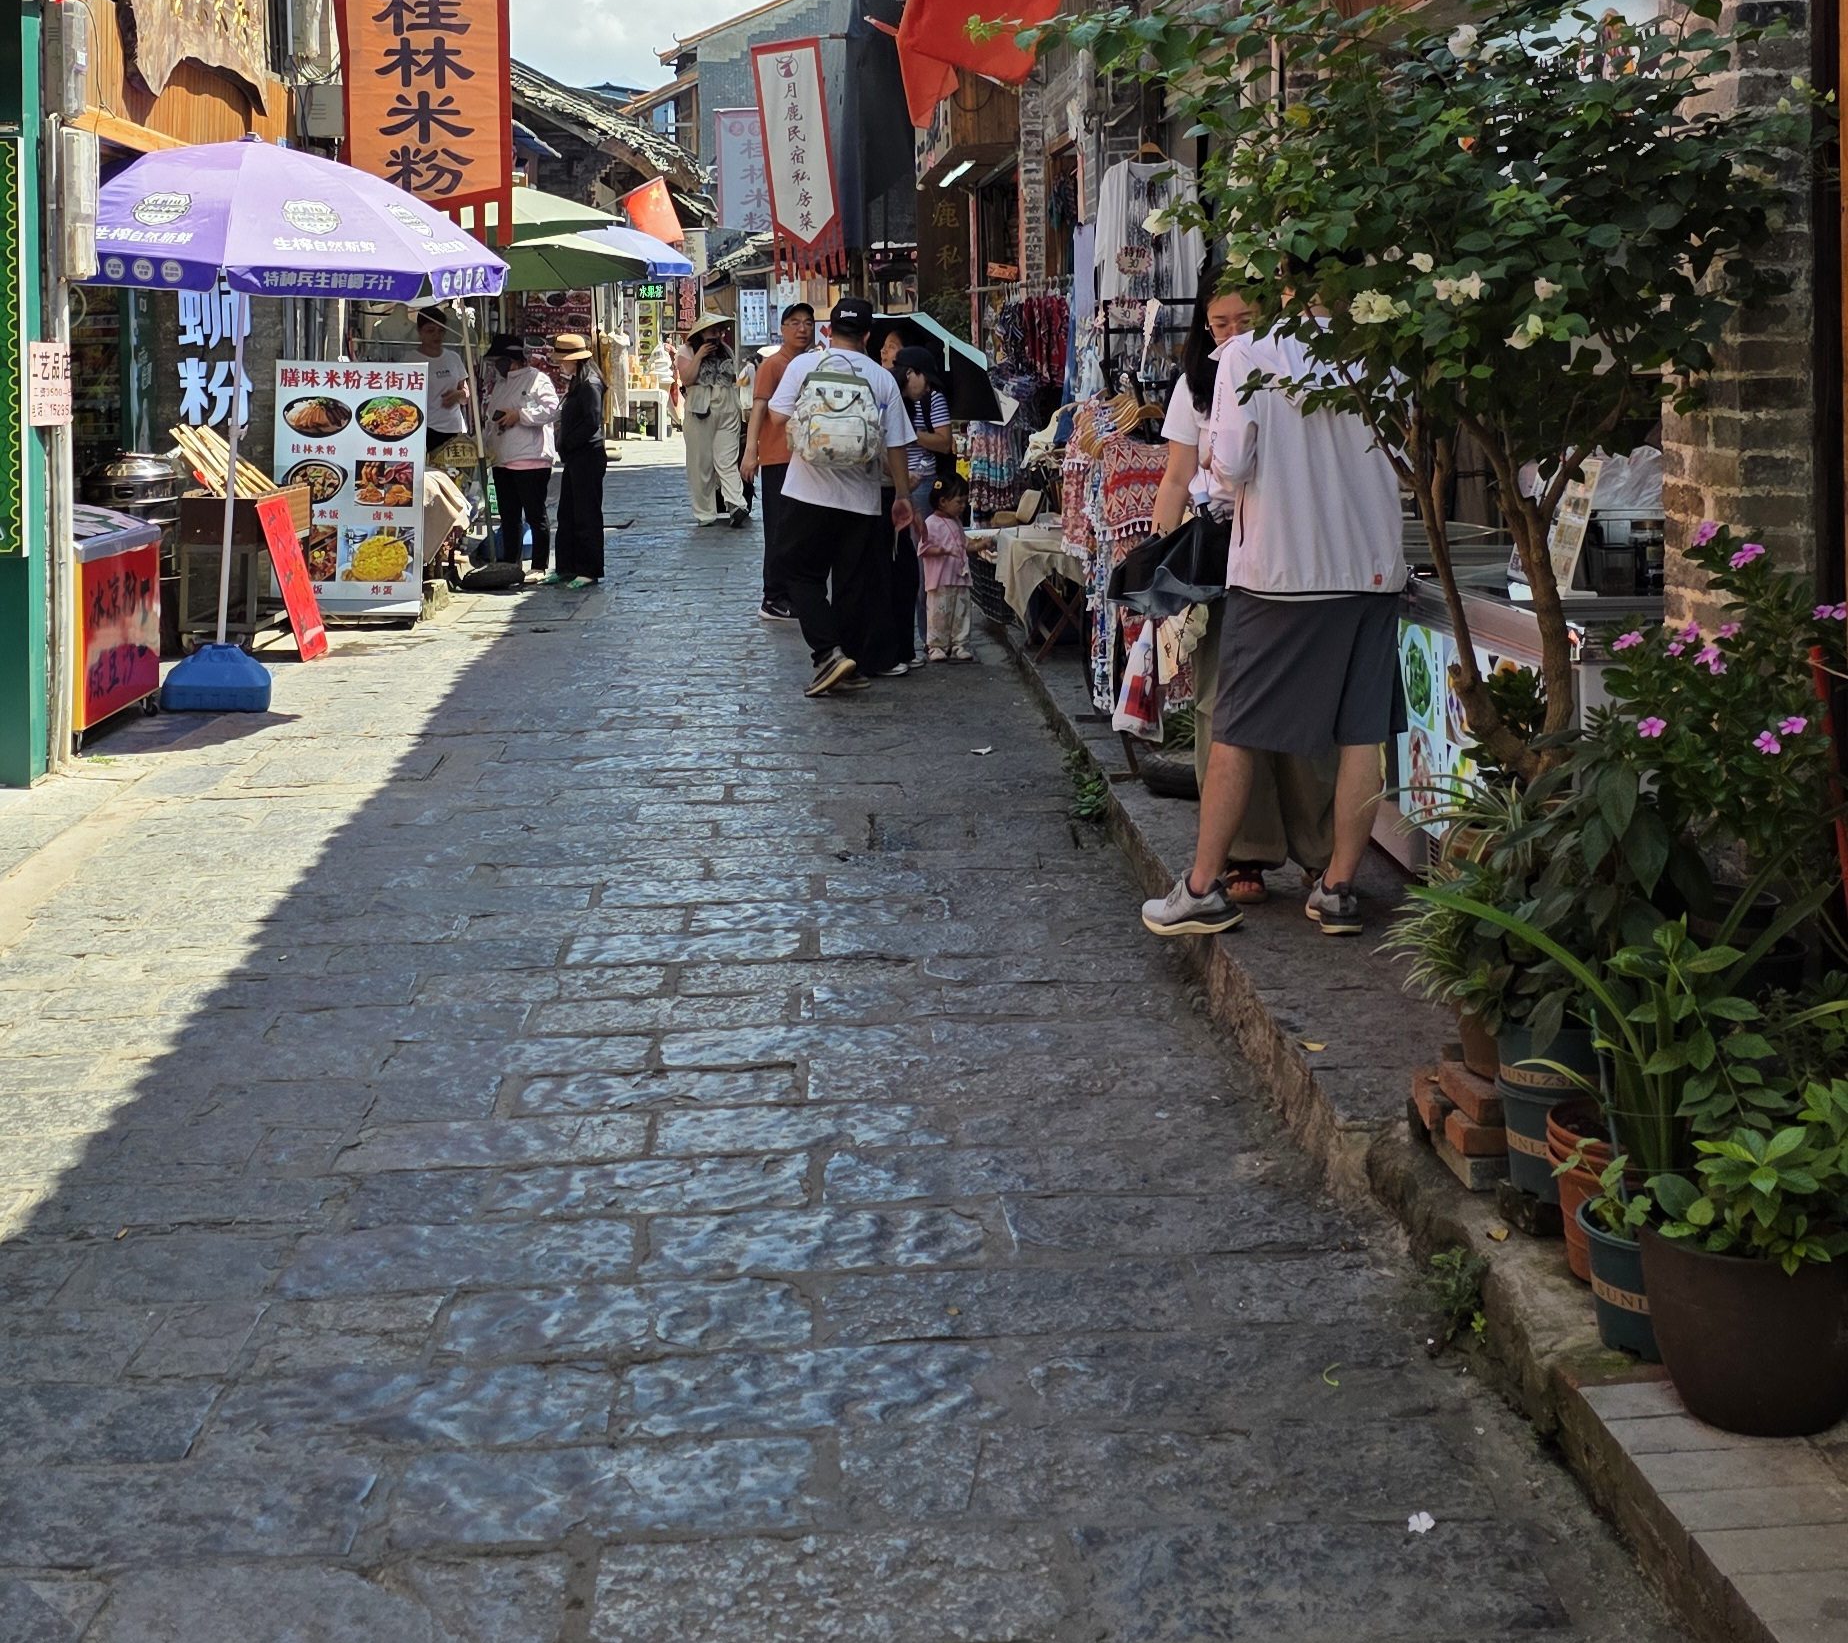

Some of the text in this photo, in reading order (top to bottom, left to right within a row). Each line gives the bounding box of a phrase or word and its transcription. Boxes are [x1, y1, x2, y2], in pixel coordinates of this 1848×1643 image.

[783, 82, 818, 232] 月鹿民宿私房菜
[272, 237, 377, 254] 生榨自然新鲜
[263, 270, 396, 291] 特种兵生榨椰子汁
[280, 368, 425, 391] 膳味米粉老街店
[291, 443, 337, 455] 桂林米粉
[372, 510, 394, 521] 卤味
[370, 584, 393, 595] 炸蛋
